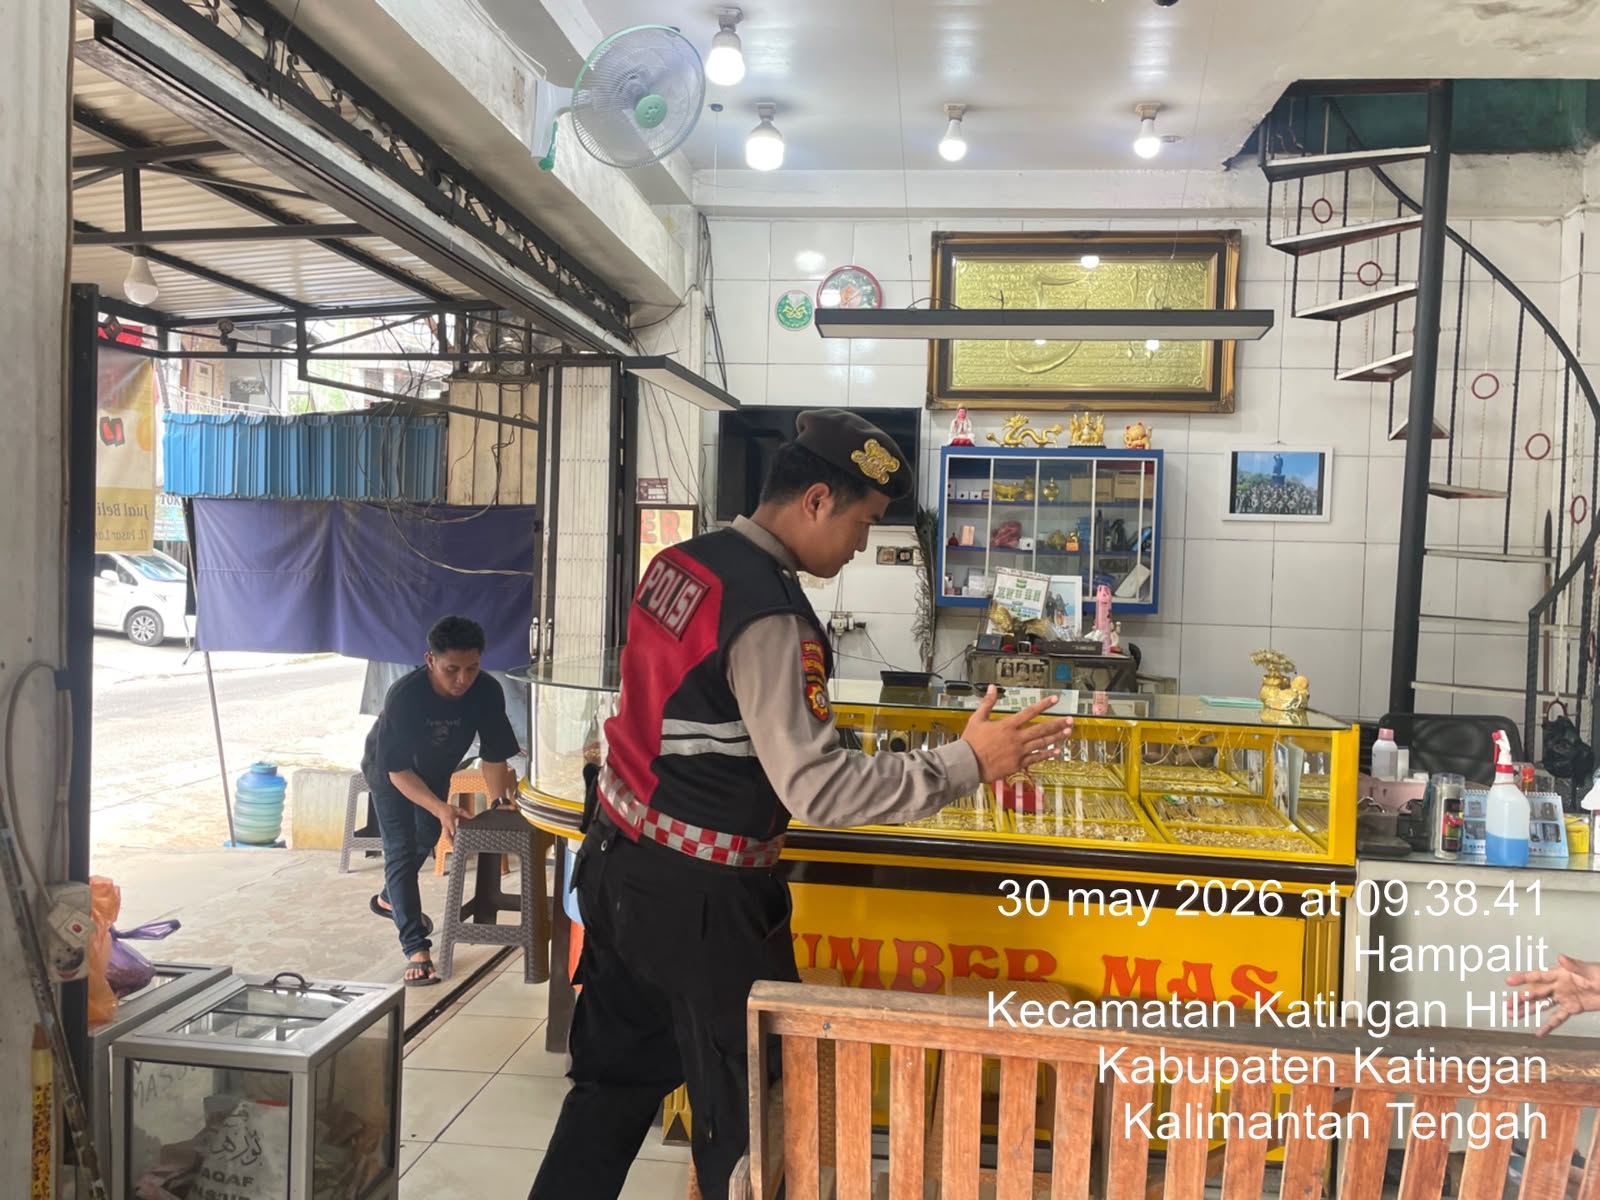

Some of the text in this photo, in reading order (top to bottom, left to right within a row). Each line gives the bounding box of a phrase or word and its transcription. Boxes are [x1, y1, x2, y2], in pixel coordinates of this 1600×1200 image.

[161, 494, 182, 506] TOK
[637, 559, 703, 634] POLISI
[1102, 954, 1278, 1008] MAS
